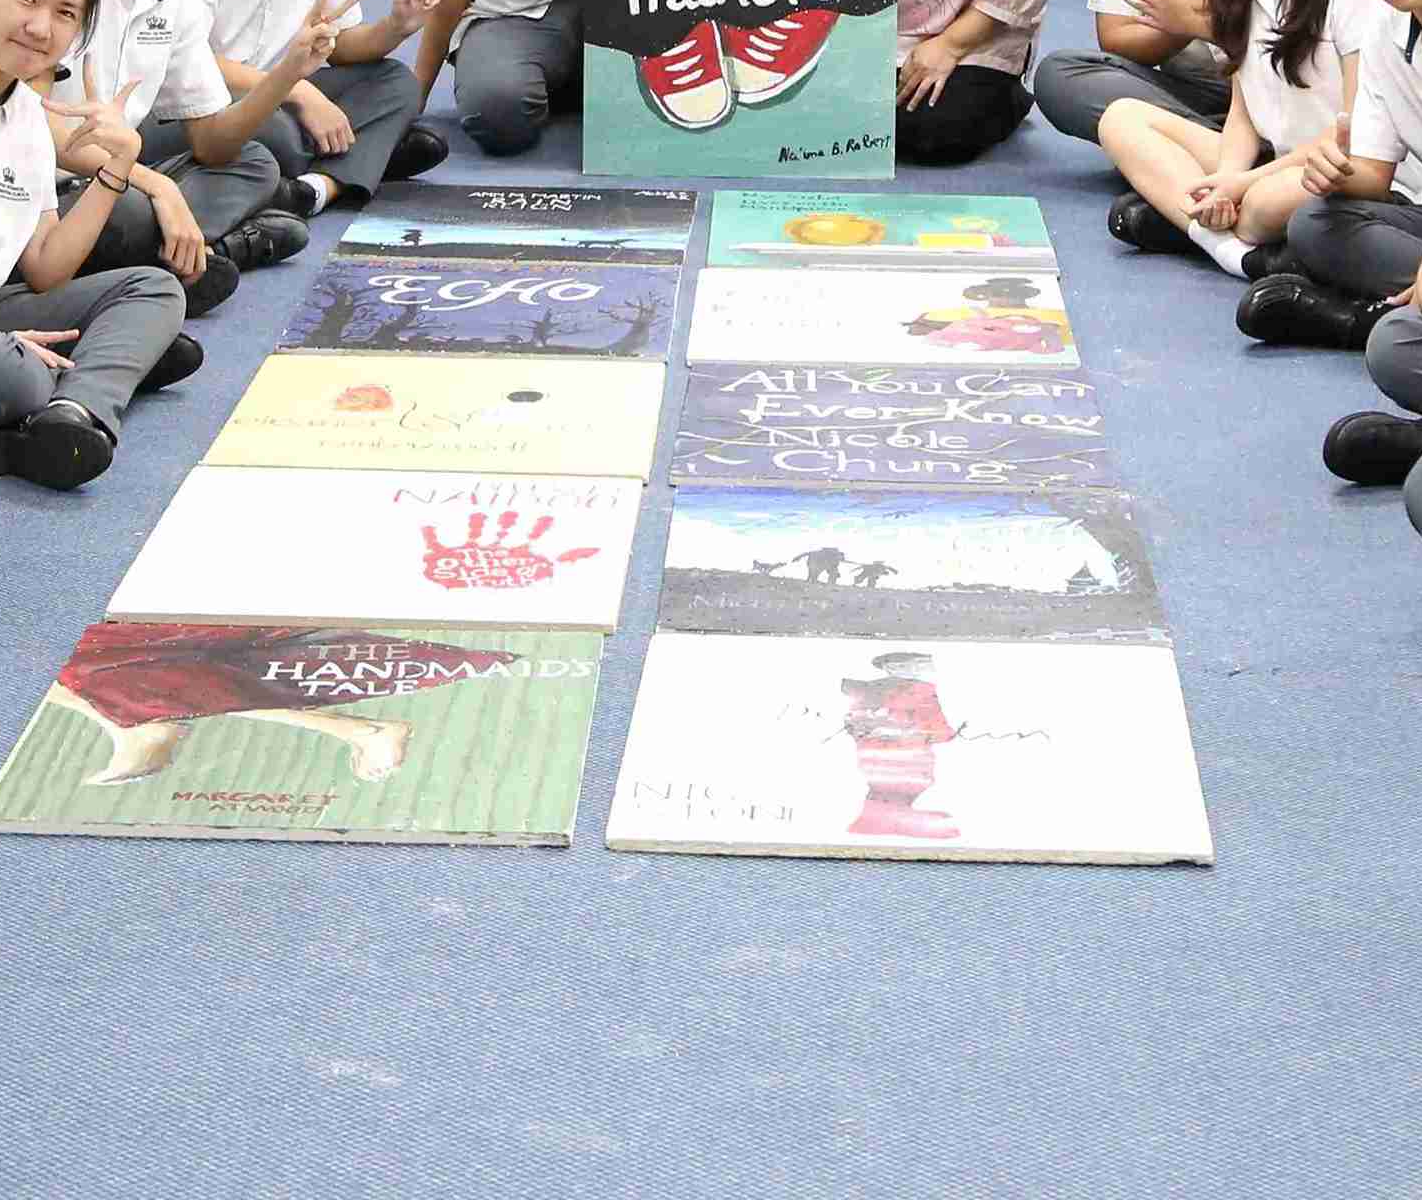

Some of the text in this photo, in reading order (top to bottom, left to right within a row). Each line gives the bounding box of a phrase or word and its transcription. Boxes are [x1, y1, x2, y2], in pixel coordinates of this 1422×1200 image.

[720, 366, 1097, 402] All You Can
[739, 393, 1105, 434] Ever Know
[766, 424, 970, 450] Nicole
[774, 450, 1018, 484] Chung
[308, 643, 411, 661] THE
[297, 680, 419, 697] TALE
[171, 790, 341, 805] MARGARET
[208, 802, 326, 815] ATWOOD
